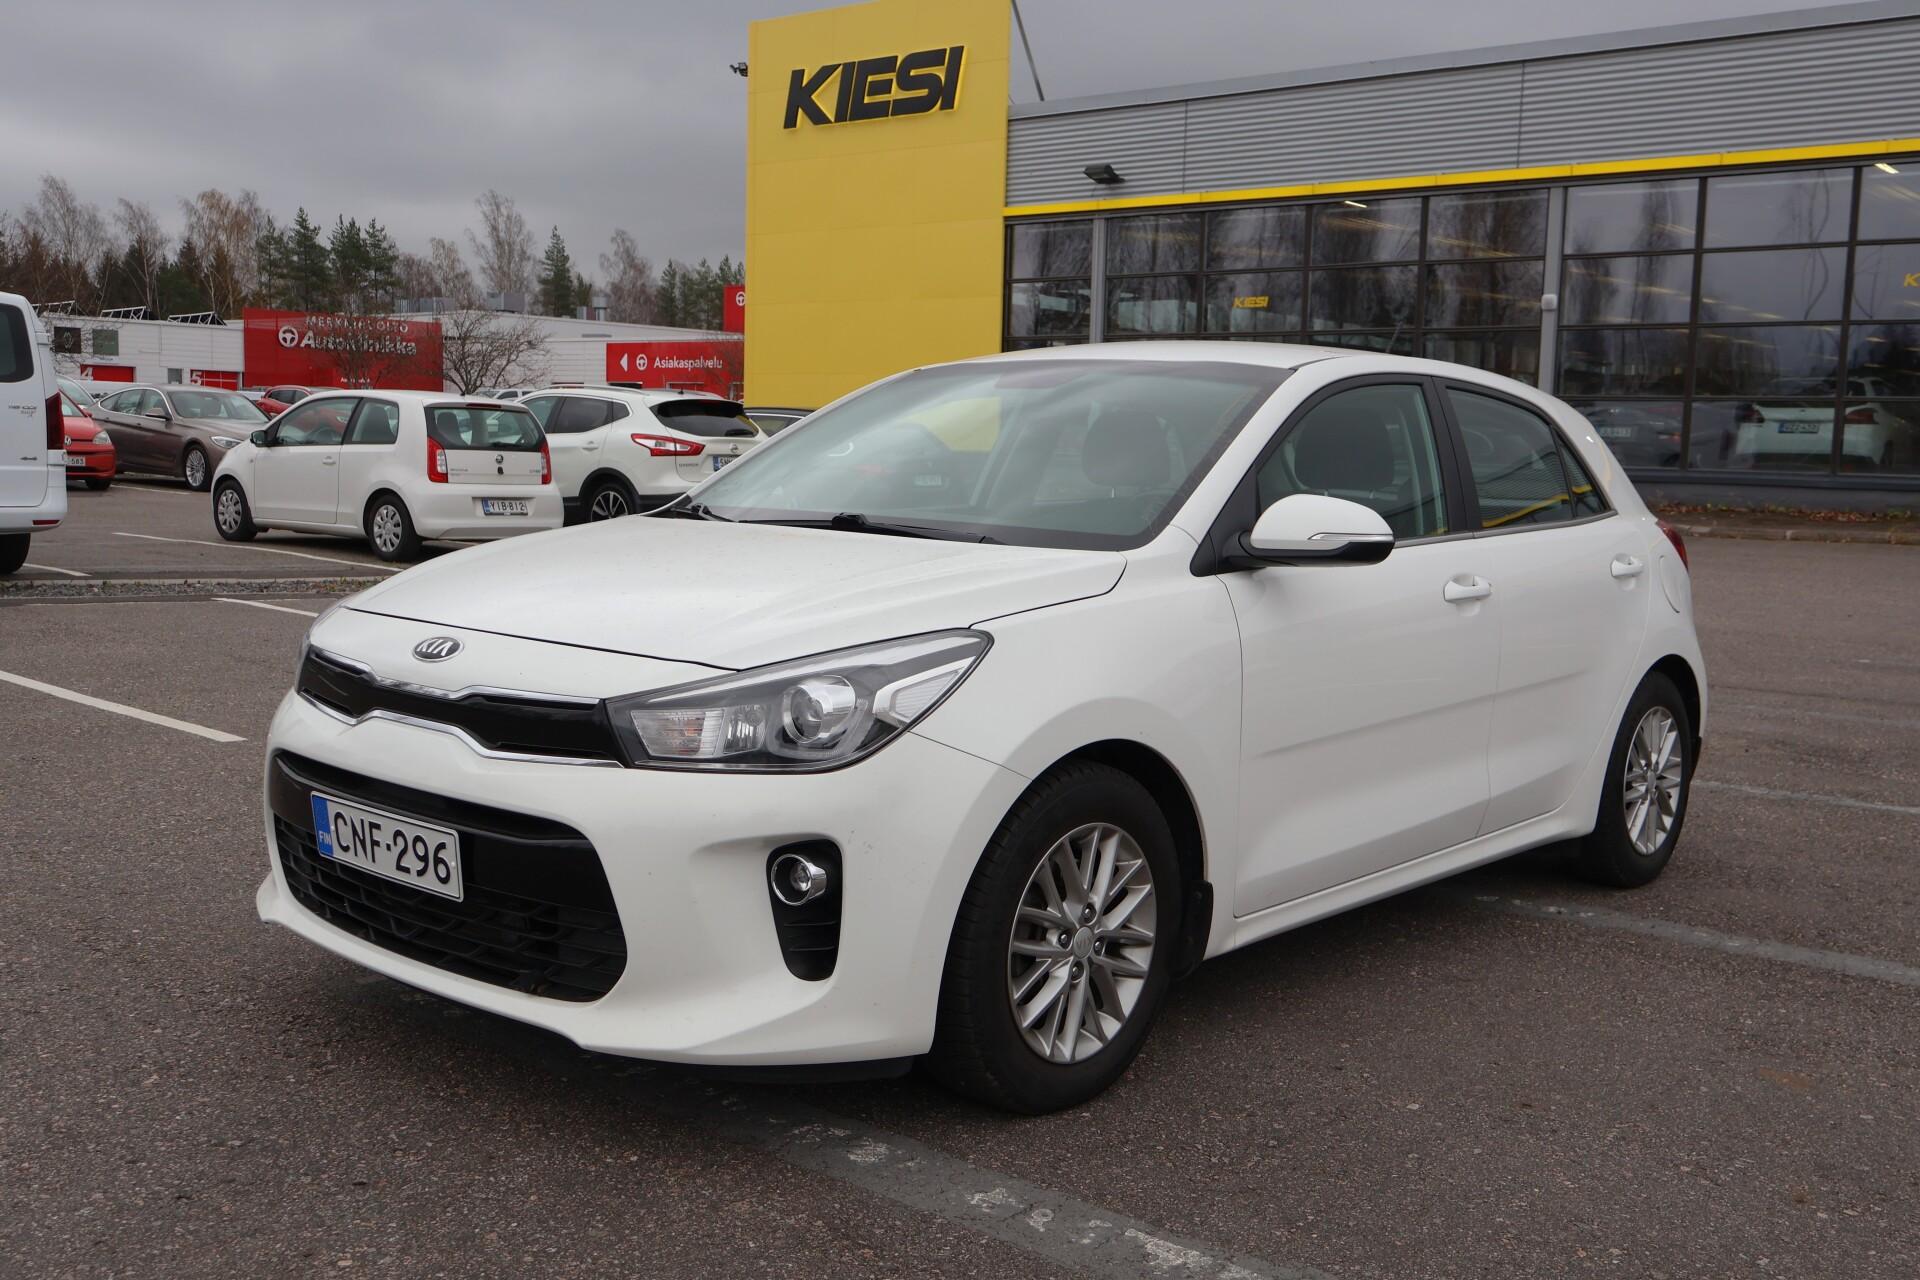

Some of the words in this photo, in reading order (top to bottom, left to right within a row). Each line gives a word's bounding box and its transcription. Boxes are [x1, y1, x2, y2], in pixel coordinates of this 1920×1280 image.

[784, 45, 965, 130] KIESI
[1232, 295, 1269, 308] KIESI
[653, 355, 723, 371] Asiakaspalvelu
[81, 366, 93, 381] 4
[191, 371, 202, 385] 5
[416, 638, 454, 656] KIA
[318, 830, 332, 847] FIN
[333, 811, 451, 885] CNF-296
